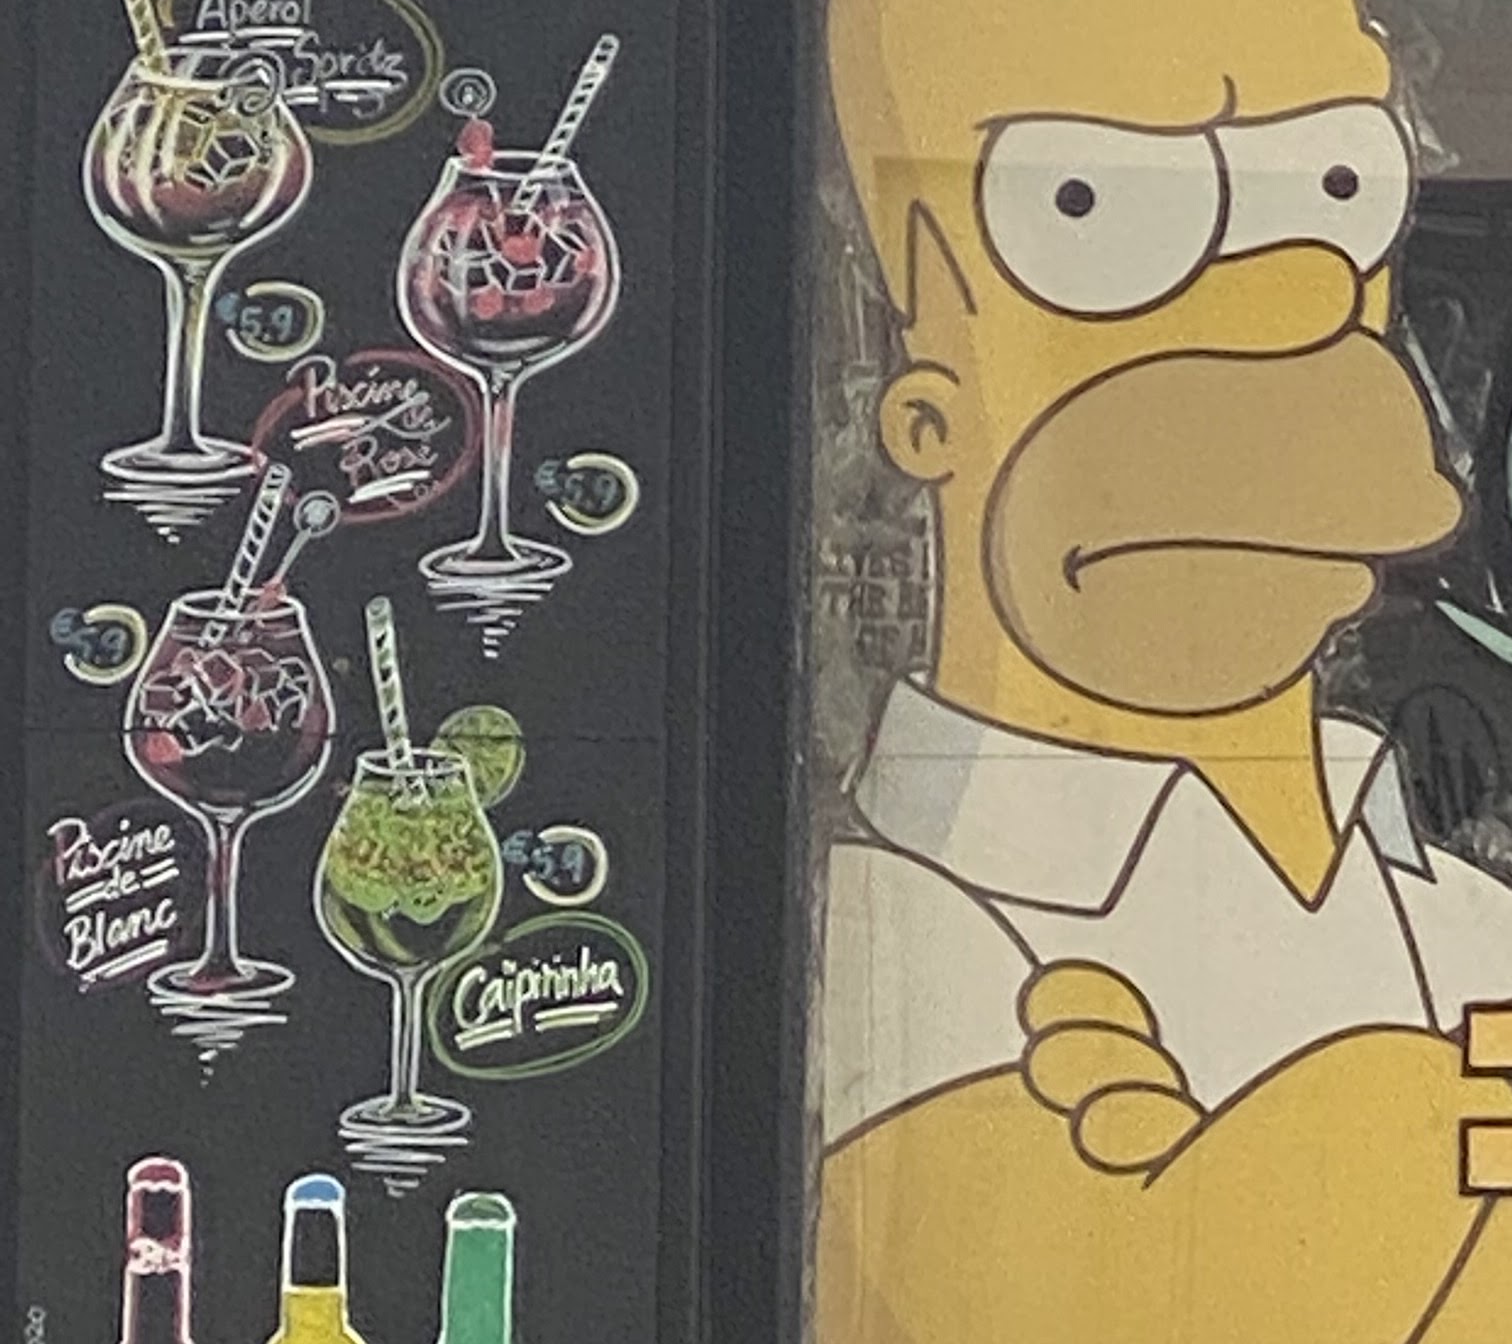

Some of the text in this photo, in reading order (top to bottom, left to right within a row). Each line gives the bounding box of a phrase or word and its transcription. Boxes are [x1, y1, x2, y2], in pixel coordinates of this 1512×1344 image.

[47, 817, 177, 886] Piscine
[102, 863, 142, 901] de
[62, 897, 178, 970] Blanc
